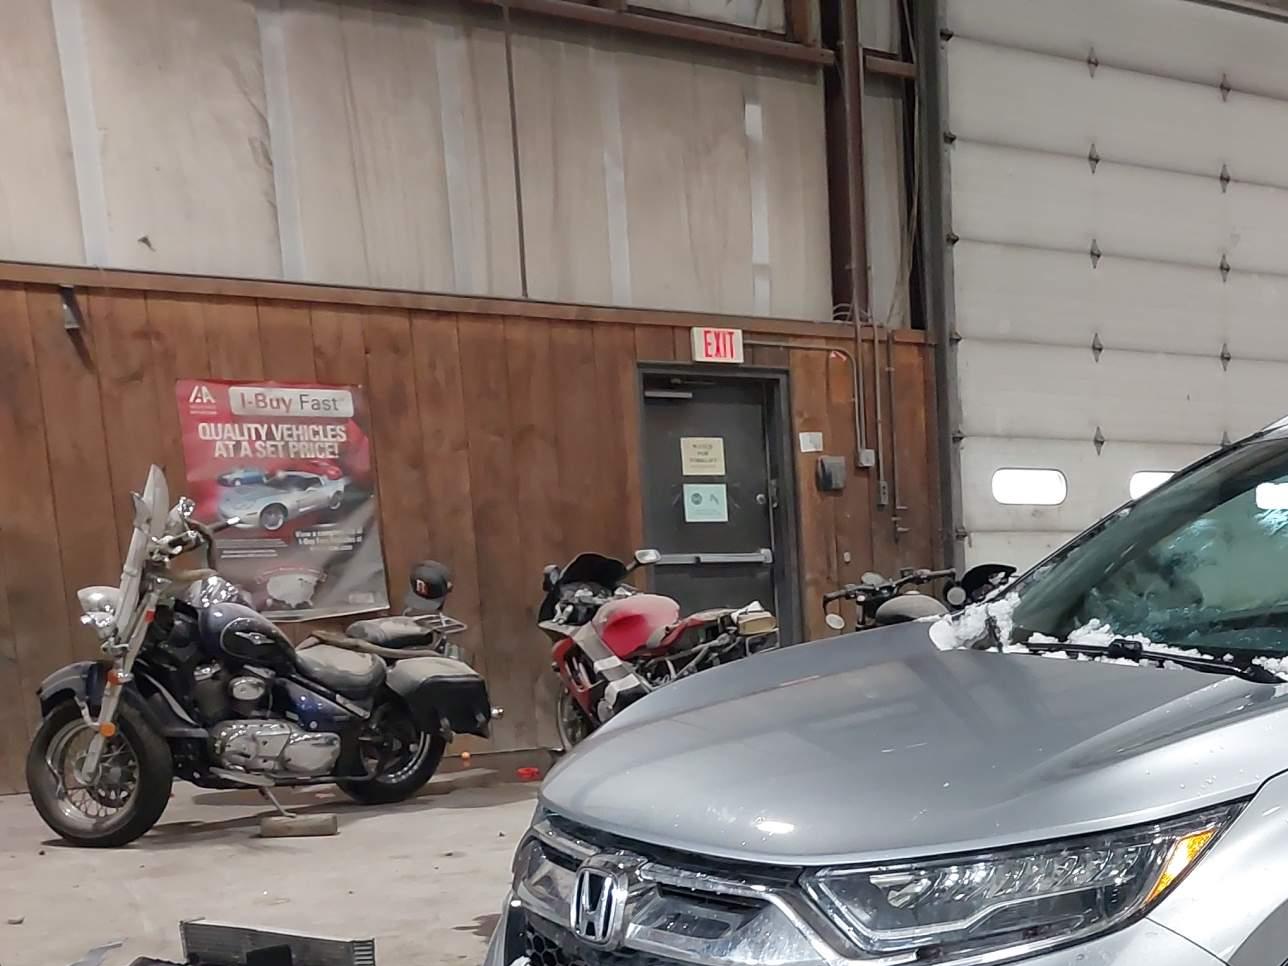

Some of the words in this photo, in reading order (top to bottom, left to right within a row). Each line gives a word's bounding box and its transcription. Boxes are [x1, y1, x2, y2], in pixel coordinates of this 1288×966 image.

[703, 330, 735, 359] EXIT
[241, 392, 292, 412] I-Buy
[300, 394, 339, 411] Fast
[198, 423, 268, 441] QUALITY
[271, 424, 347, 442] VEHICLES
[214, 441, 236, 458] AT
[239, 442, 251, 458] A
[254, 442, 286, 458] SET
[288, 442, 340, 459] PRICE!
